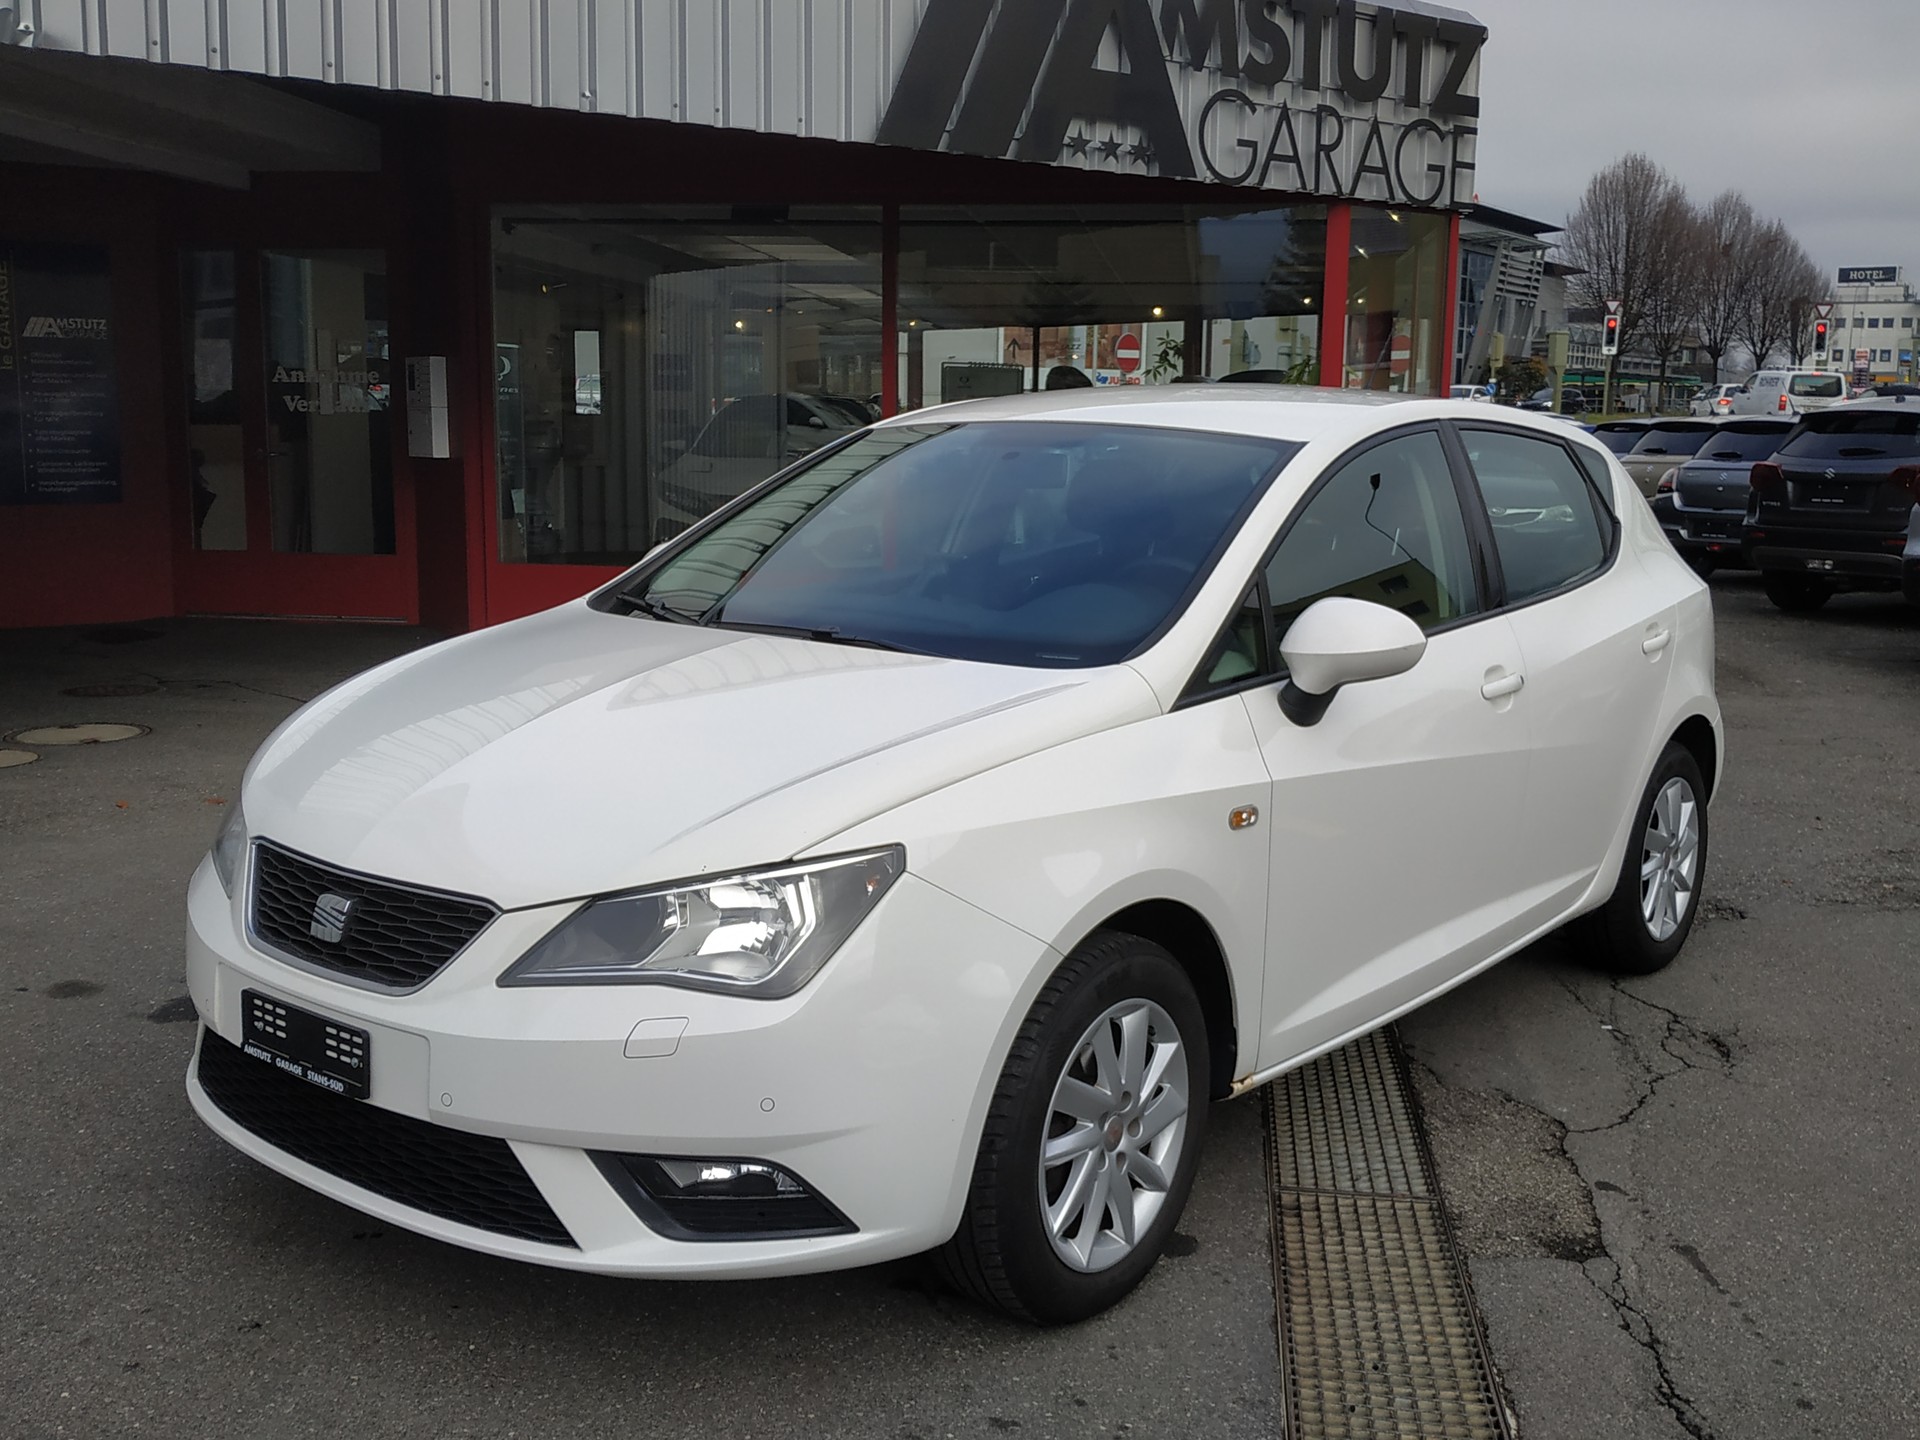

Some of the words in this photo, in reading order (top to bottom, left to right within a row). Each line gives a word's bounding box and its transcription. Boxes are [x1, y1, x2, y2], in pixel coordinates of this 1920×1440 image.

[1200, 88, 1477, 210] GARAGE
[1848, 270, 1886, 280] HOTEL
[36, 316, 108, 338] AMSTUTZ
[243, 1043, 272, 1063] AMSTUTZ
[275, 1057, 302, 1075] GARAGE
